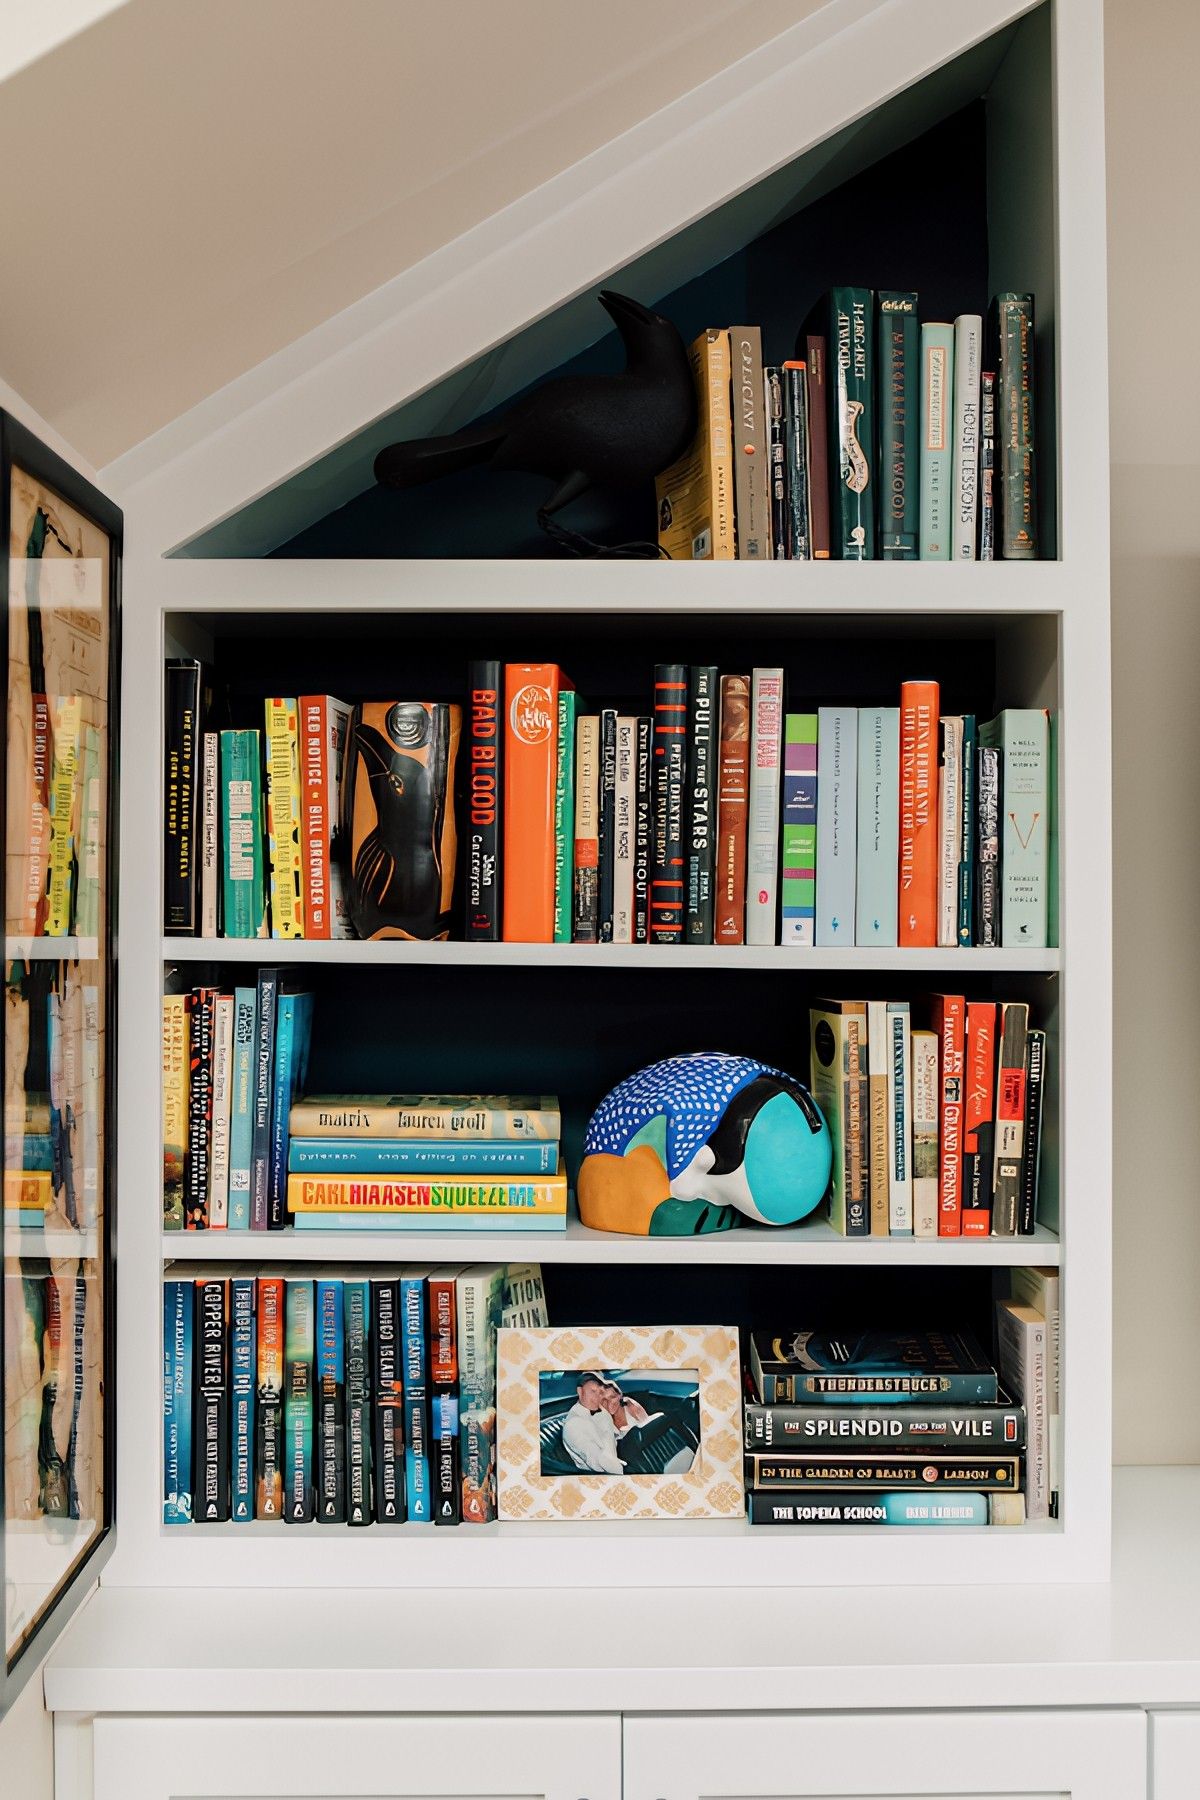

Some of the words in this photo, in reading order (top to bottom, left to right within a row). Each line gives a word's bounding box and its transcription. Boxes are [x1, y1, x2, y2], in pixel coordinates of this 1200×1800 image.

[852, 302, 867, 380] MARGARET
[892, 331, 906, 427] MARGARET
[962, 403, 978, 454] HOUSE
[891, 440, 907, 520] ATWOOD
[960, 459, 977, 524] LESSONS
[699, 674, 709, 695] THE
[184, 711, 193, 730] THE
[307, 706, 321, 732] RED
[471, 689, 497, 738] BAD
[694, 697, 711, 745] PULL
[916, 705, 930, 749] ELENA
[170, 751, 179, 779] JOHN
[182, 735, 193, 759] CITY
[308, 738, 322, 786] NOTICE
[670, 743, 682, 782] PETE
[697, 748, 708, 761] OF
[182, 765, 191, 779] OF
[470, 745, 497, 826] BLOOD
[696, 765, 708, 784] THE
[916, 753, 929, 828] FERRANTE
[181, 785, 191, 830] FALLING
[309, 805, 323, 835] BILL
[637, 803, 648, 847] PARIS
[669, 784, 681, 842] DEXTER
[692, 788, 709, 850] STARS
[903, 812, 914, 830] OF
[310, 840, 325, 905] BROWDER
[482, 854, 497, 886] John
[635, 851, 648, 900] TROUT
[699, 871, 710, 900] EMMA
[172, 1004, 183, 1074] CHARLES
[318, 1109, 371, 1128] matrix
[397, 1111, 446, 1130] lauren
[944, 1105, 960, 1152] GRAND
[214, 1118, 228, 1181] GAINES
[302, 1181, 350, 1206] CARL
[350, 1183, 430, 1207] HIAASEN
[430, 1184, 508, 1209] SQUEEZE
[508, 1185, 537, 1208] ME
[943, 1154, 959, 1212] OPENING
[204, 1284, 222, 1338] COPPER
[236, 1286, 250, 1341] THUNDER
[379, 1288, 394, 1340] WINDIGO
[406, 1288, 421, 1336] MANITOU
[203, 1344, 222, 1385] RIVER
[236, 1347, 250, 1368] BAY
[380, 1344, 395, 1388] ISLAND
[407, 1337, 421, 1381] CANYON
[292, 1361, 308, 1399] ANGLE
[349, 1357, 365, 1404] COUNTY
[817, 1376, 939, 1393] THUNDERSTRUCK
[803, 1419, 903, 1437] SPLENDID
[950, 1419, 993, 1437] VILE
[762, 1467, 776, 1477] IN
[778, 1467, 803, 1478] THE
[805, 1468, 854, 1478] GARDEN
[856, 1469, 872, 1479] OF
[875, 1469, 917, 1479] BEASTS
[943, 1470, 989, 1480] LARSON
[772, 1506, 794, 1519] THE
[796, 1506, 841, 1519] TOPEKA
[843, 1506, 887, 1519] SCHOOL
